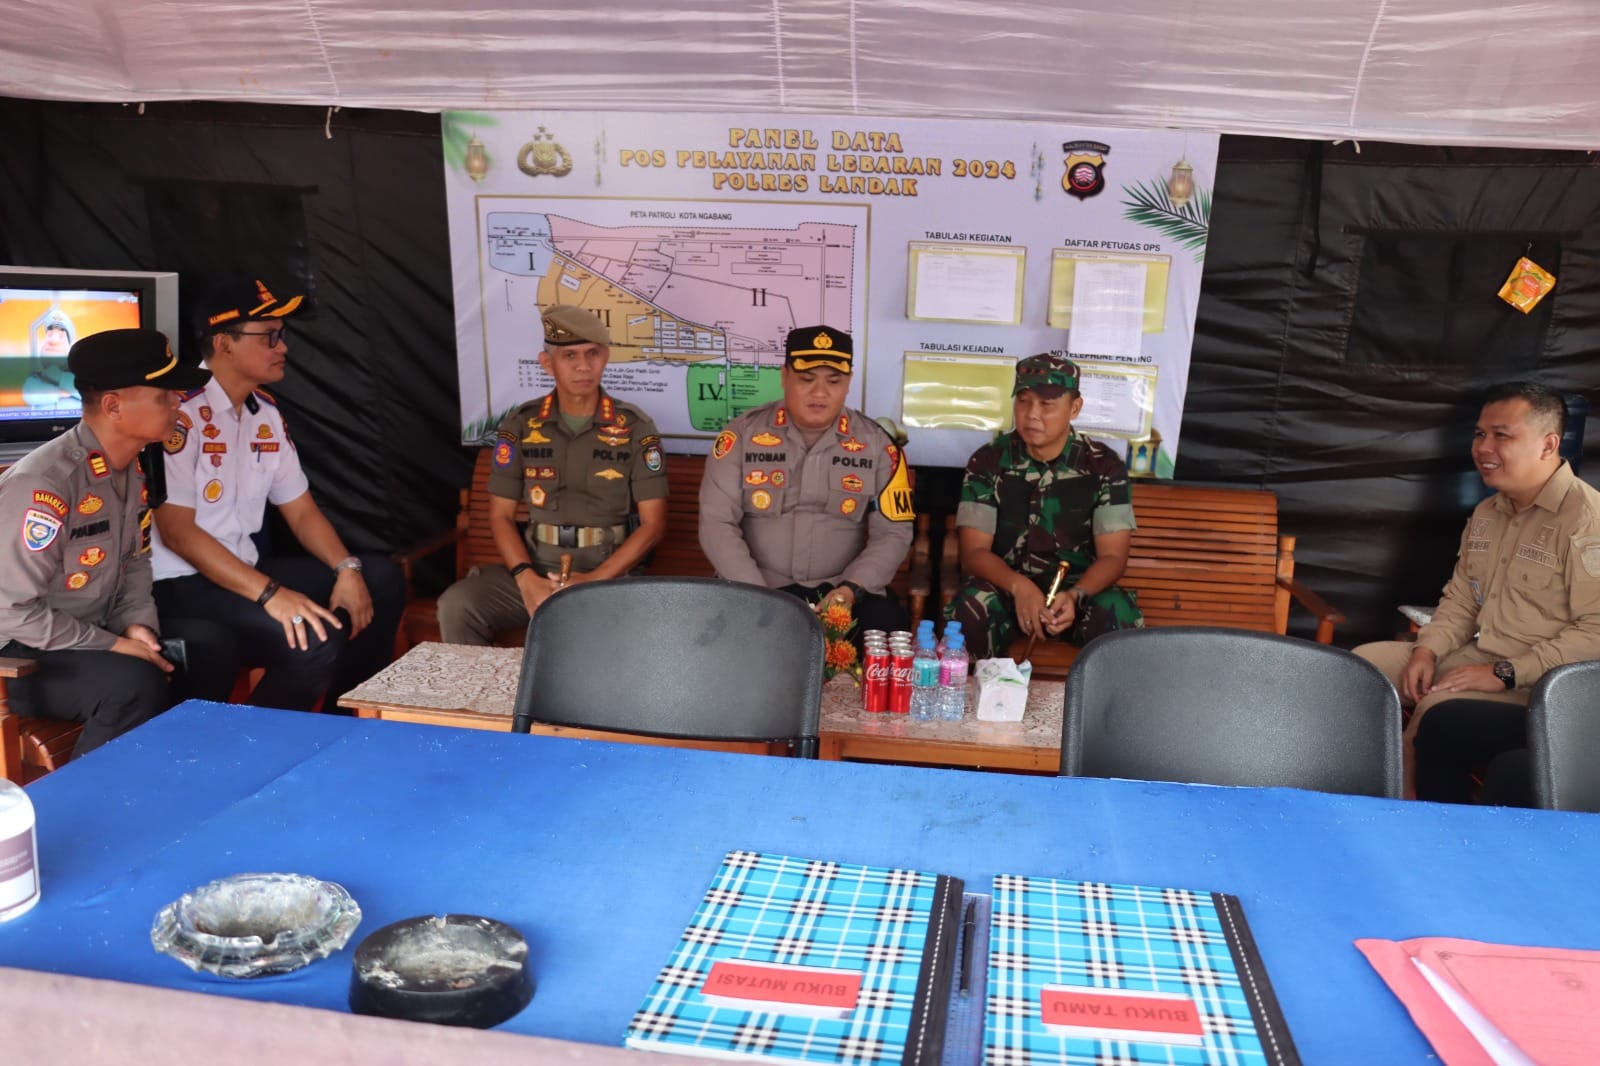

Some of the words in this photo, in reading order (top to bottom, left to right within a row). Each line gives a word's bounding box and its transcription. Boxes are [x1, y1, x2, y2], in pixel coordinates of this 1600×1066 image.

[728, 128, 818, 150] PANEL
[832, 130, 904, 153] DATA
[619, 149, 667, 168] POS
[676, 150, 816, 171] PELAYANAN
[827, 153, 942, 176] LEBARAN
[952, 158, 1017, 180] 2024
[712, 172, 809, 193] POLRES
[818, 174, 918, 197] LANDAK
[630, 210, 647, 219] PETA
[648, 211, 676, 219] PATROLI
[679, 211, 697, 220] KOTA
[698, 212, 733, 221] NGABANG
[925, 231, 967, 241] TABULASI
[969, 233, 1012, 243] KEGIATAN
[1064, 238, 1099, 248] DAFTAR
[1101, 240, 1141, 251] PETUGAS
[1143, 243, 1161, 252] OPS
[752, 287, 768, 307] II
[920, 342, 961, 352] TABULASI
[963, 344, 1004, 354] KEJADIAN
[593, 449, 614, 460] POL
[617, 451, 631, 461] PP
[745, 452, 786, 463] NYOMAN
[832, 455, 873, 469] POLRI
[716, 973, 788, 990] MUTASI
[793, 980, 847, 997] BUKU
[1053, 1000, 1117, 1017] TAMU
[1125, 1006, 1190, 1022] BUKU
